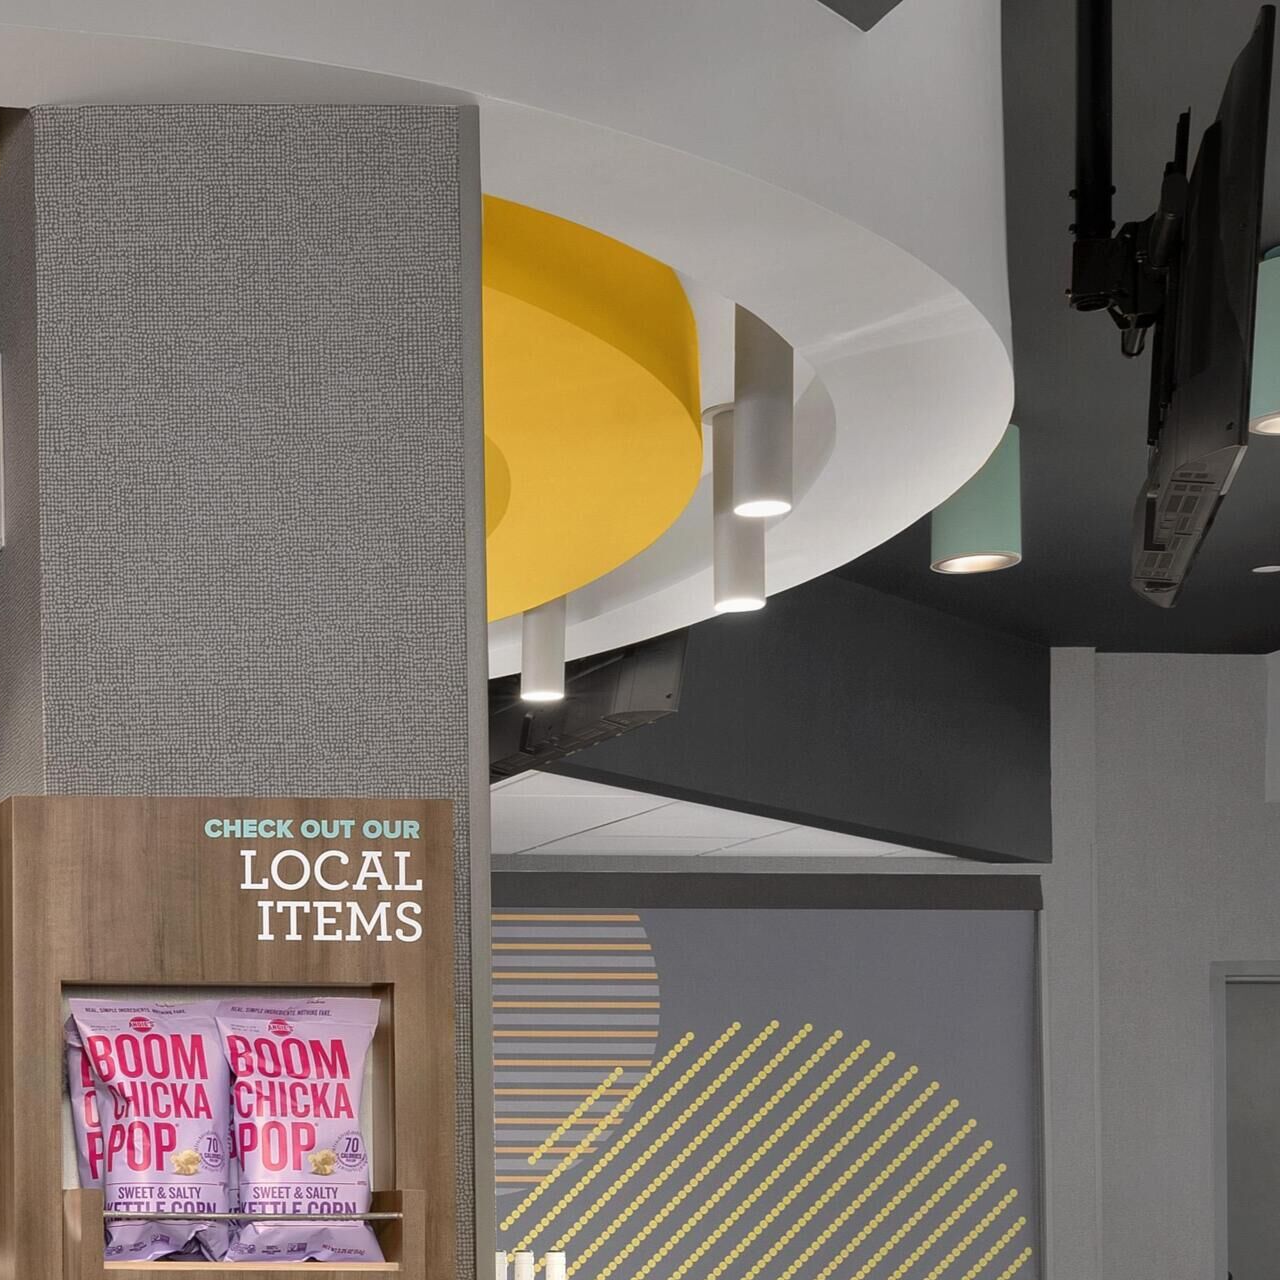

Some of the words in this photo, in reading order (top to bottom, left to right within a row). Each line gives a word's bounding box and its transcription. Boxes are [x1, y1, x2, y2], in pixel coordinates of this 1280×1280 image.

[204, 818, 294, 838] CHECK
[300, 819, 355, 839] OUT
[362, 820, 420, 839] OUR
[240, 850, 423, 891] LOCAL
[257, 901, 422, 942] ITEMS
[87, 1034, 208, 1083] BOOM
[226, 1035, 351, 1080] BOOM
[108, 1081, 213, 1120] CHICKA
[234, 1081, 354, 1120] CHICKA
[108, 1121, 177, 1172] POP
[207, 1137, 219, 1153] 70
[239, 1121, 316, 1172] POP
[345, 1137, 359, 1154] 70
[118, 1186, 155, 1200] SWEET
[157, 1187, 166, 1199] &
[168, 1186, 202, 1200] SALTY
[253, 1186, 291, 1200] SWEET
[294, 1187, 303, 1200] &
[305, 1187, 339, 1200] SALTY
